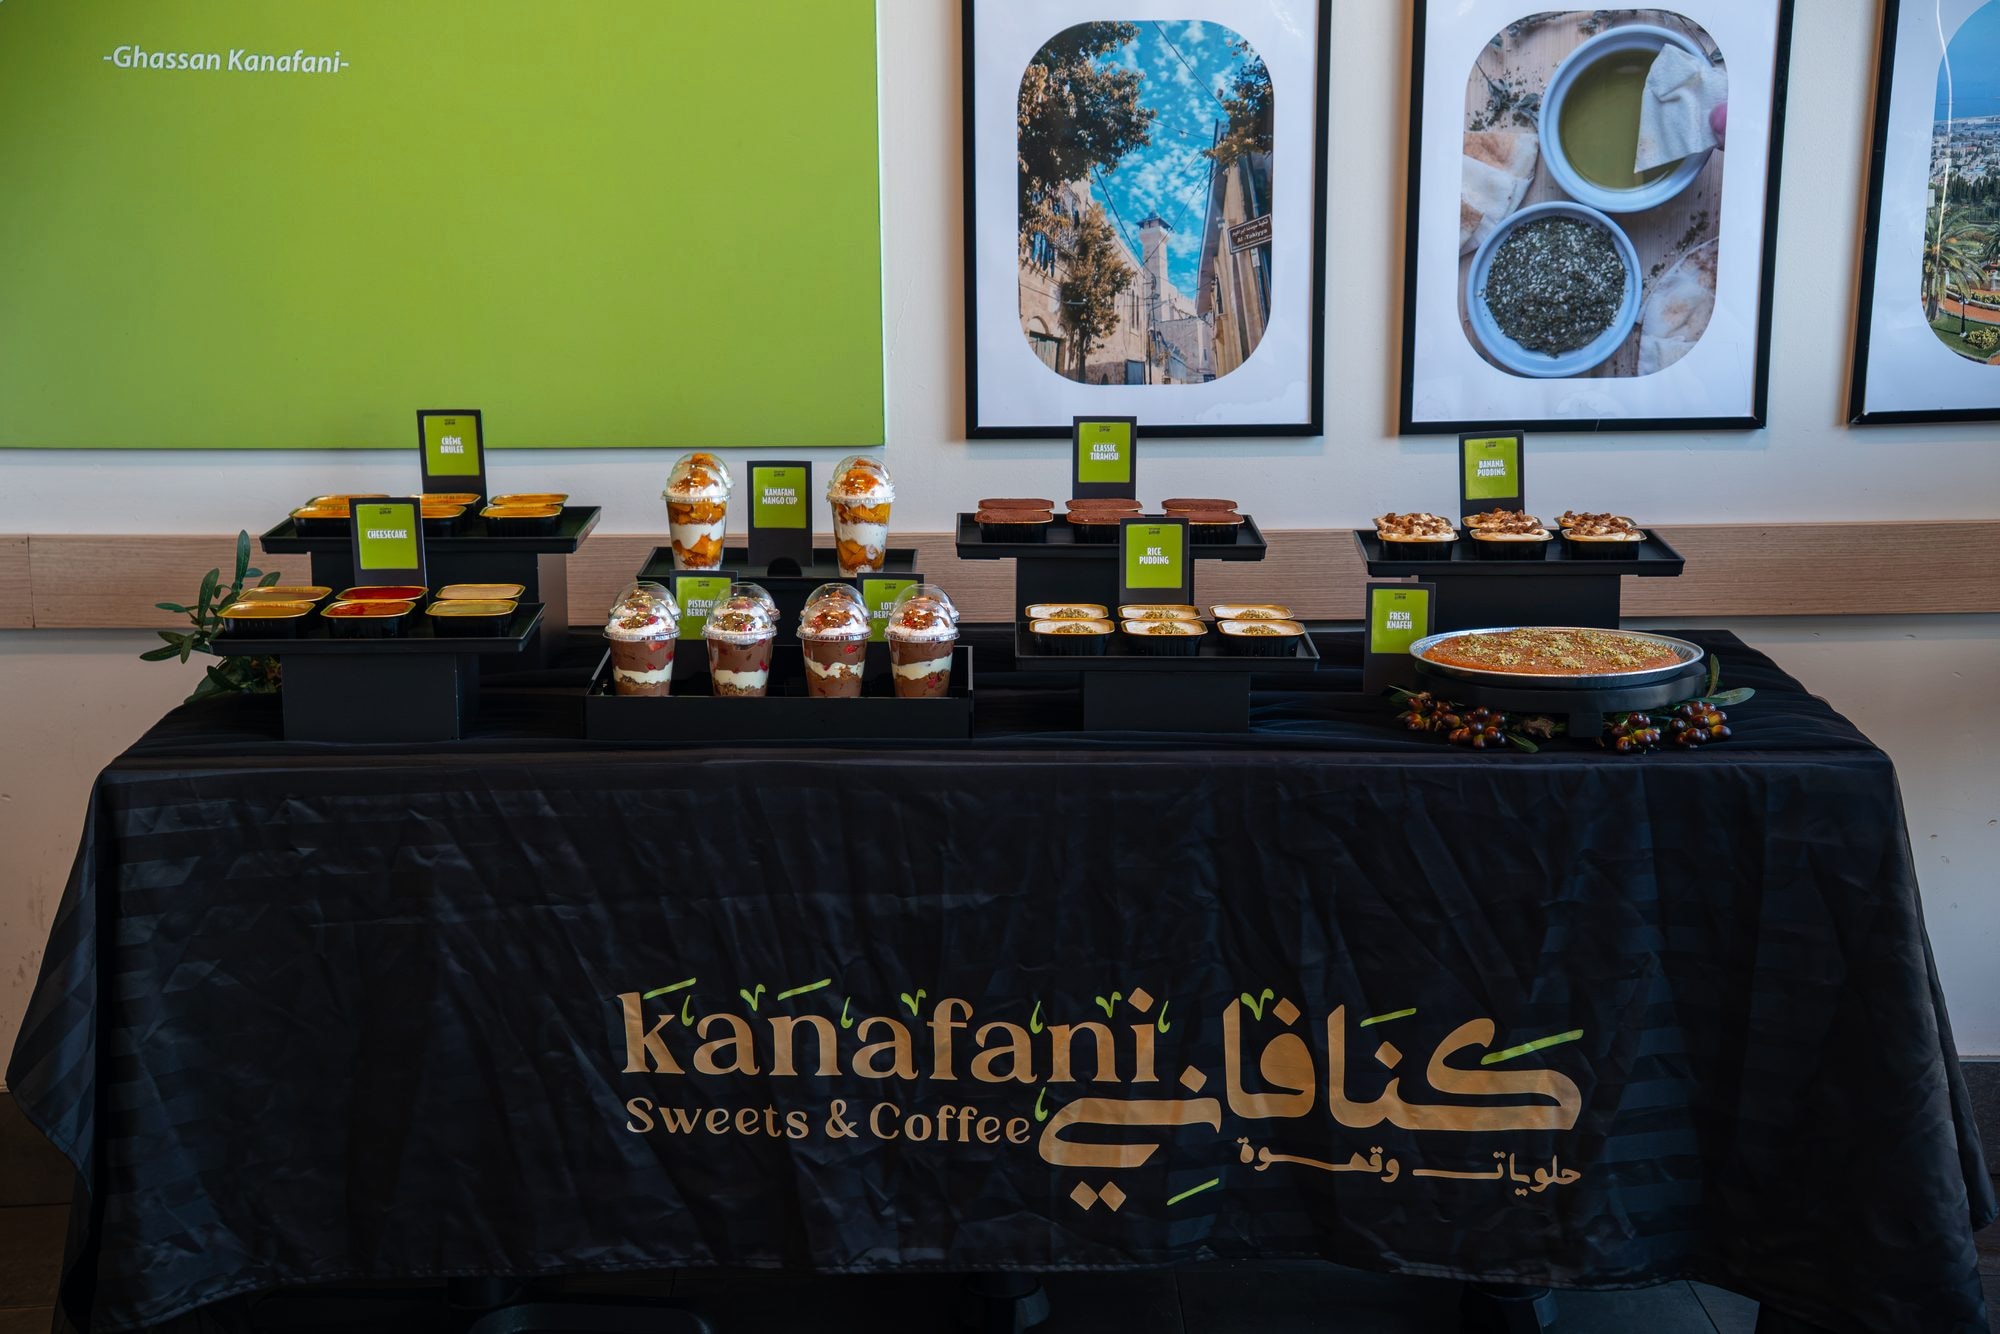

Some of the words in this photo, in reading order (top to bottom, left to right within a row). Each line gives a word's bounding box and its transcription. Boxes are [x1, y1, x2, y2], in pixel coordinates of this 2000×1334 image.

[103, 45, 221, 70] -Ghassan
[227, 49, 350, 73] Kanafani-
[1093, 444, 1117, 452] CLASSIC
[1090, 452, 1119, 461] TIRAMISU
[1478, 460, 1504, 468] BANANA
[1477, 468, 1506, 477] PUDDING
[764, 488, 795, 496] KANAFANI
[762, 496, 784, 504] MANGO
[785, 496, 798, 504] CUP
[367, 529, 408, 539] CHEESECAKE
[1146, 547, 1161, 556] RICE
[1139, 556, 1169, 565] PUDDING
[687, 599, 721, 608] PISTACH
[1390, 611, 1411, 620] FRESH
[1387, 620, 1413, 630] KNAFEH
[617, 988, 1160, 1083] kanafani
[1038, 996, 1584, 1212] كنافاني
[626, 1097, 809, 1139] Sweets
[825, 1099, 859, 1138] &
[869, 1102, 1031, 1144] Coffee
[1237, 1136, 1400, 1183] وقهوة
[1412, 1151, 1582, 1197] حلويات
